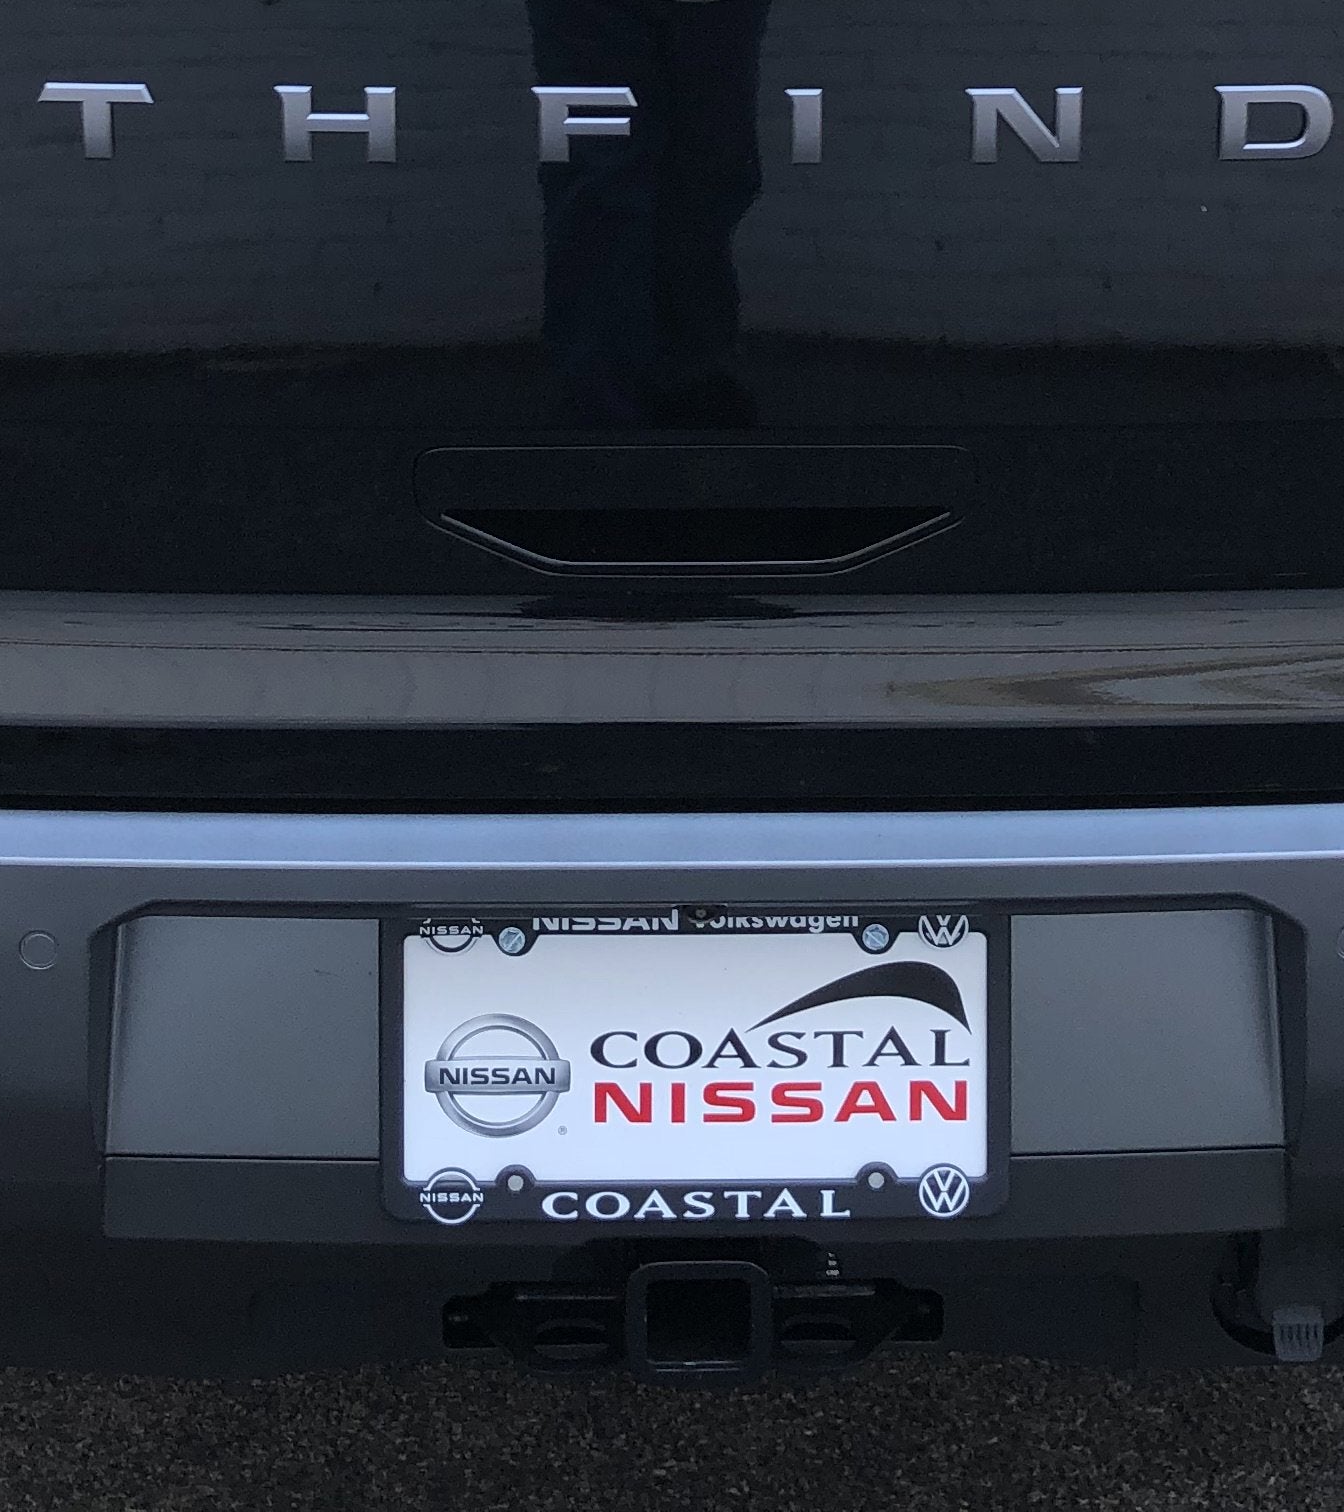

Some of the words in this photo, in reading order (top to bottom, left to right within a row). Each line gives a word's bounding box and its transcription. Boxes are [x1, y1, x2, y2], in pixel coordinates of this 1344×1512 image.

[419, 925, 484, 936] NISSAN
[590, 1028, 970, 1070] COASTAL
[439, 1067, 556, 1086] NISSAN
[594, 1080, 968, 1124] NISSAN
[419, 1192, 484, 1204] NISSAN
[541, 1189, 851, 1219] COASTAL
